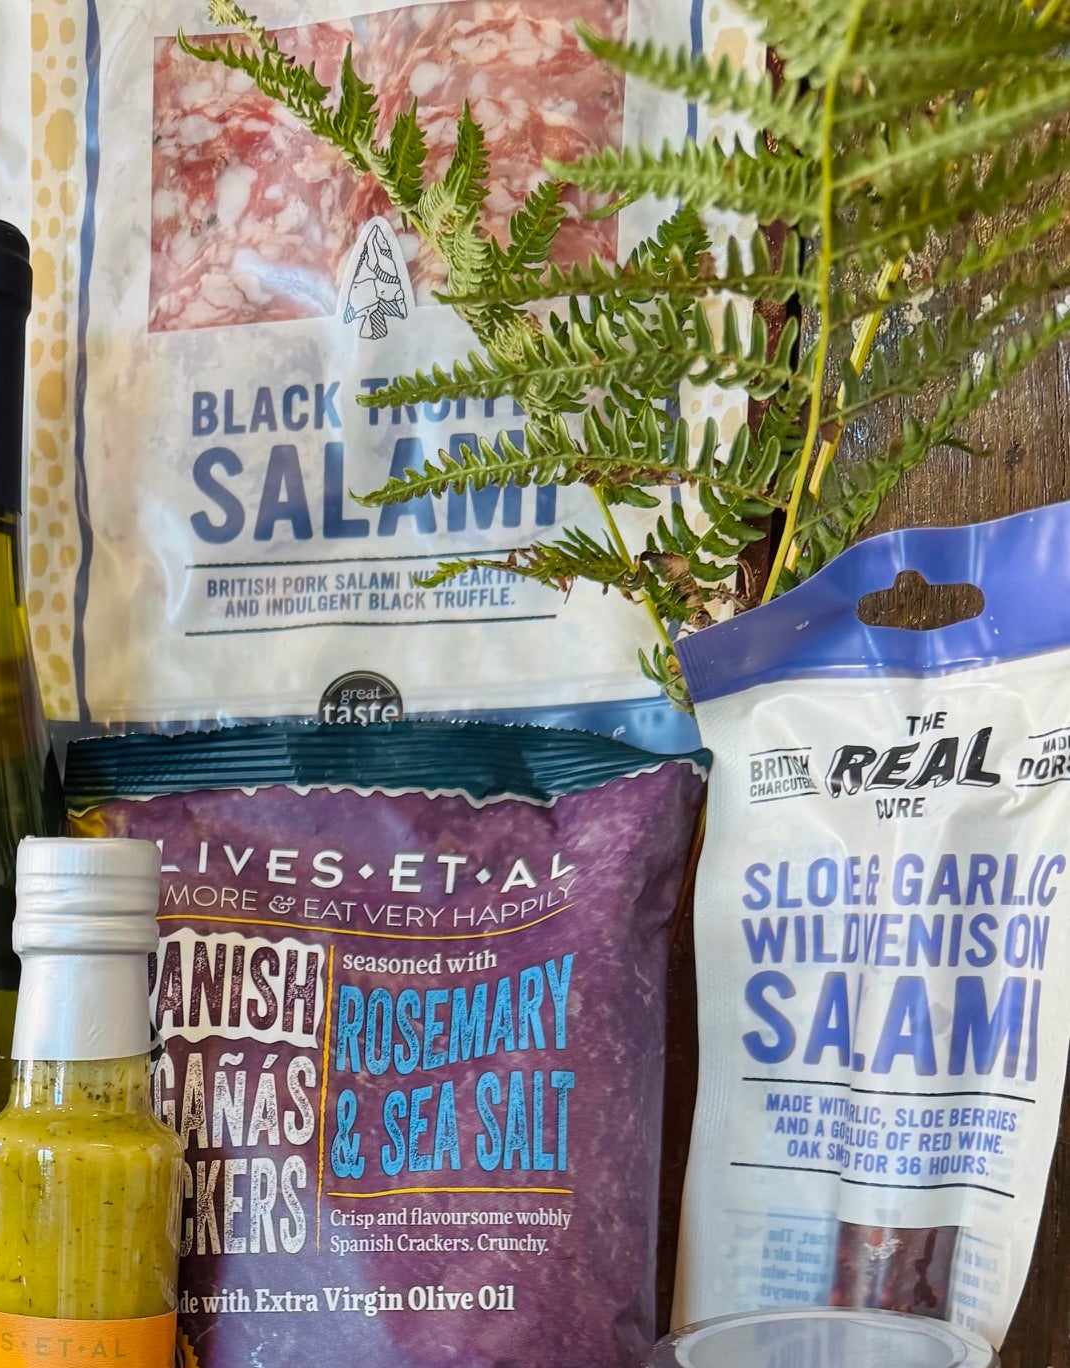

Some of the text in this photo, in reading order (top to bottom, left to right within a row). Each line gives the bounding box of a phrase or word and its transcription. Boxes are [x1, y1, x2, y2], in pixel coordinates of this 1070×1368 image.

[192, 380, 343, 437] BLACK
[206, 573, 328, 598] BRITISH PORK
[266, 592, 426, 617] INDULGENT BLACK
[340, 685, 381, 703] great
[322, 700, 400, 724] taste
[906, 711, 948, 736] THE
[825, 727, 1001, 799] REAL
[875, 797, 926, 820] CURE
[741, 853, 1067, 911] SLOE GARLIC
[164, 879, 577, 929] MORE VERY HAPPILY
[741, 912, 1050, 970] WILD VENISON
[343, 950, 498, 976] seasoned with
[335, 953, 575, 1076] ROSEMARY
[380, 1070, 576, 1177] SEA SALT
[949, 1107, 1017, 1132] BERRIES
[918, 1131, 1004, 1155] RED WINE.
[895, 1155, 922, 1175] 36
[330, 1208, 572, 1231] Crisp flavoursome wobbly
[330, 1233, 550, 1257] Spanish Crackers. Crunchy.
[255, 1285, 516, 1319] Extra Virgin Olive Oil
